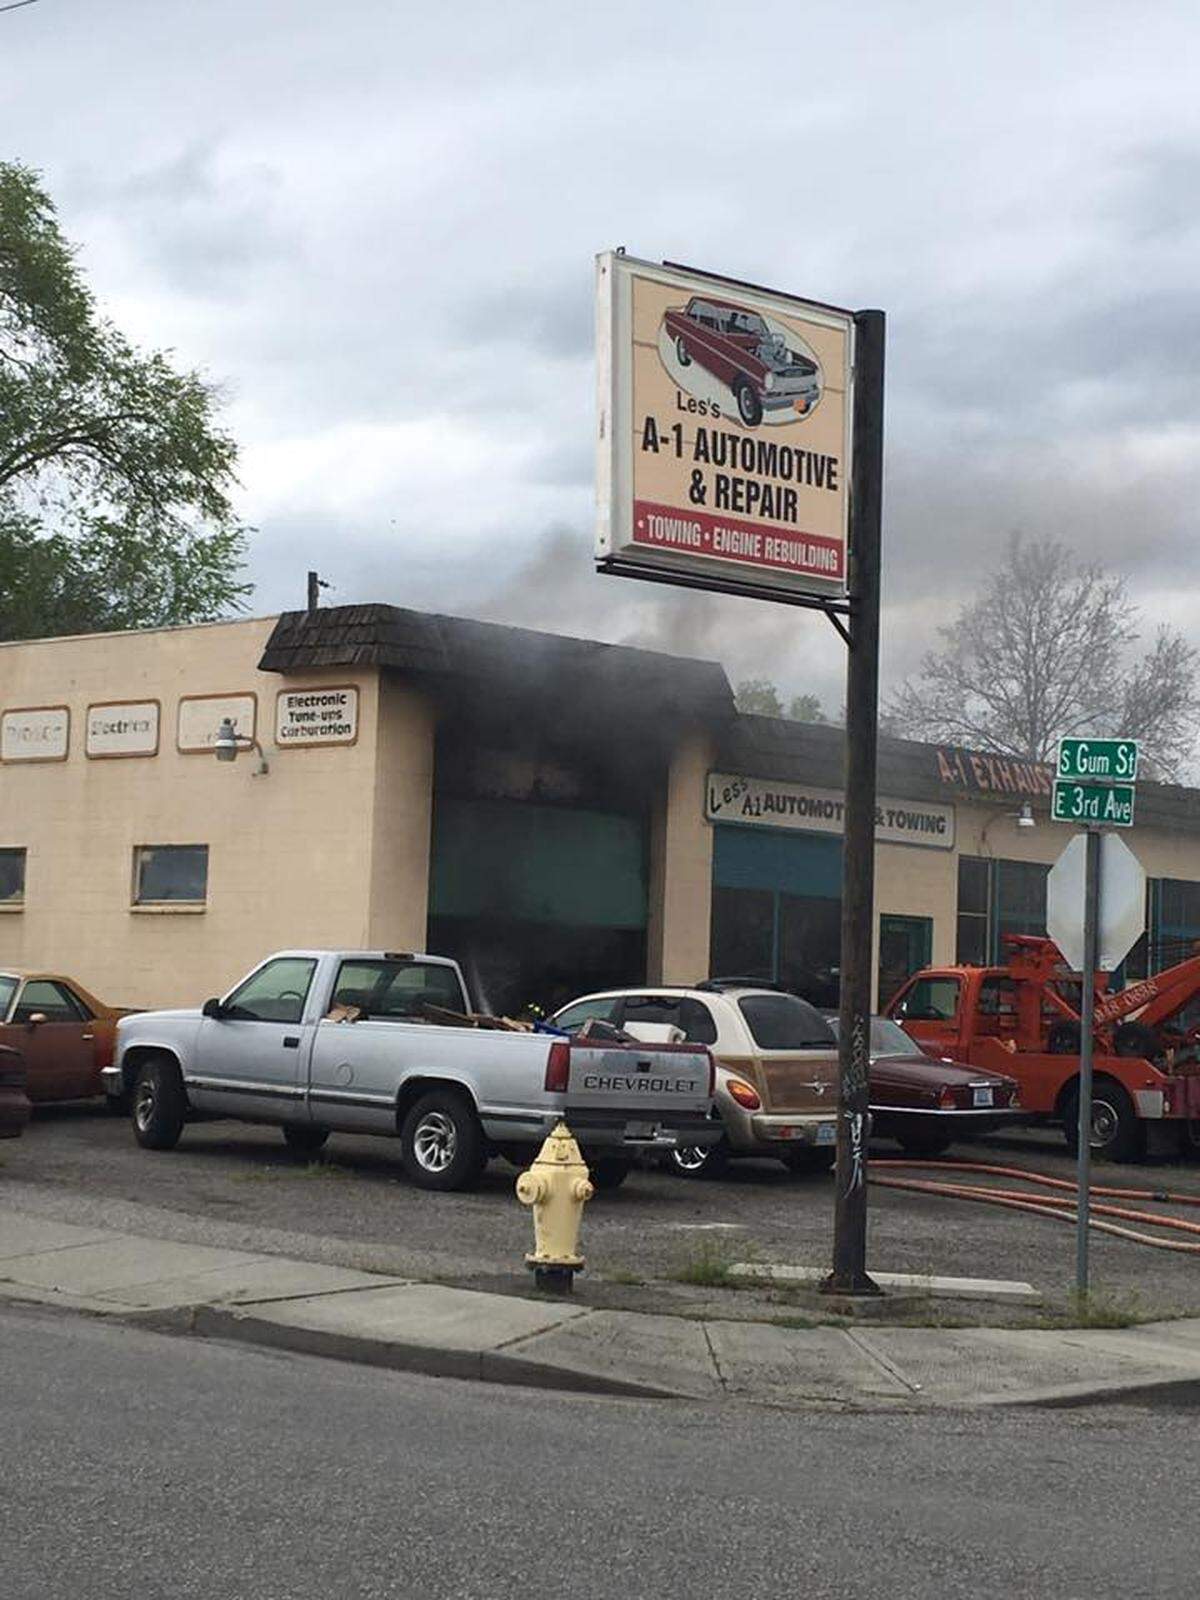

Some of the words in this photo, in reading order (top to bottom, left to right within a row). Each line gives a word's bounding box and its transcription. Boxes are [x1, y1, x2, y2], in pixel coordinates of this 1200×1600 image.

[676, 391, 720, 419] Les's
[641, 415, 683, 458] A-1
[693, 427, 838, 491] AUTOMOTIVE
[688, 468, 706, 506] &
[714, 473, 797, 524] REPAIR
[647, 514, 700, 546] TOWING
[713, 526, 761, 559] ENGINE
[765, 537, 838, 572] REBUILDING
[286, 693, 347, 709] Electronic
[288, 709, 343, 724] Tune-ups
[280, 723, 351, 738] Carburation
[1061, 749, 1070, 772] S
[1076, 743, 1109, 773] Gum
[1116, 744, 1135, 775] St
[970, 756, 1051, 796] EXHAUS
[763, 792, 845, 821] AUTOMOT
[873, 806, 885, 826] &
[887, 810, 947, 834] TOWING
[1056, 791, 1066, 814] E
[1071, 786, 1100, 817] 3rd
[1104, 790, 1131, 820] Ave
[583, 1075, 699, 1093] CHEVROLET
